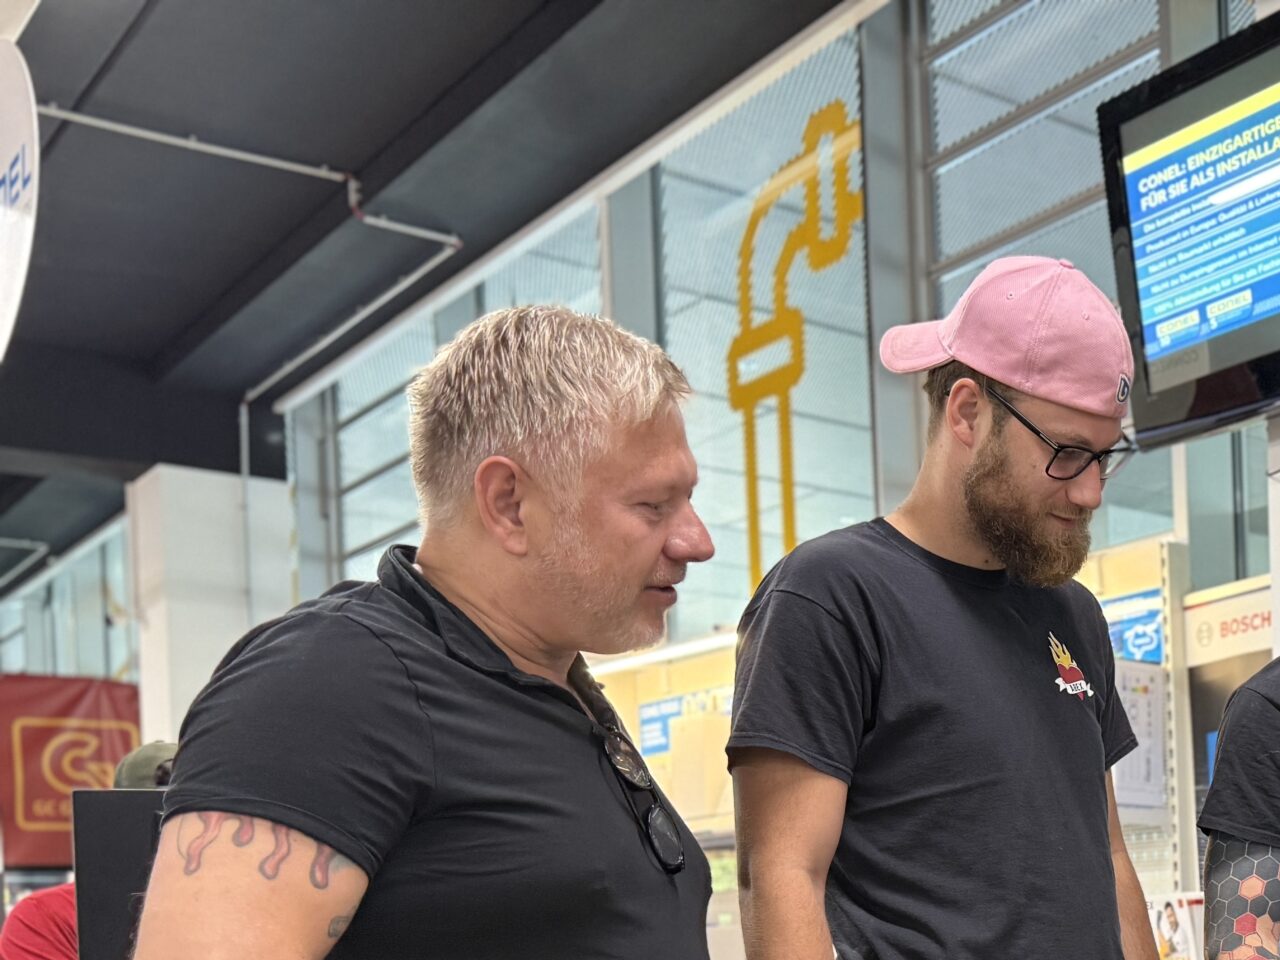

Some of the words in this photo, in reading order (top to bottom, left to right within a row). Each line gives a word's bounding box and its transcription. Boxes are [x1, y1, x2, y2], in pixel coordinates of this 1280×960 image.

[1138, 162, 1187, 193] CONEL:
[1140, 188, 1168, 212] FÜR
[1167, 180, 1188, 199] SIE
[1190, 166, 1215, 189] ALS
[1220, 611, 1272, 638] BOSCH
